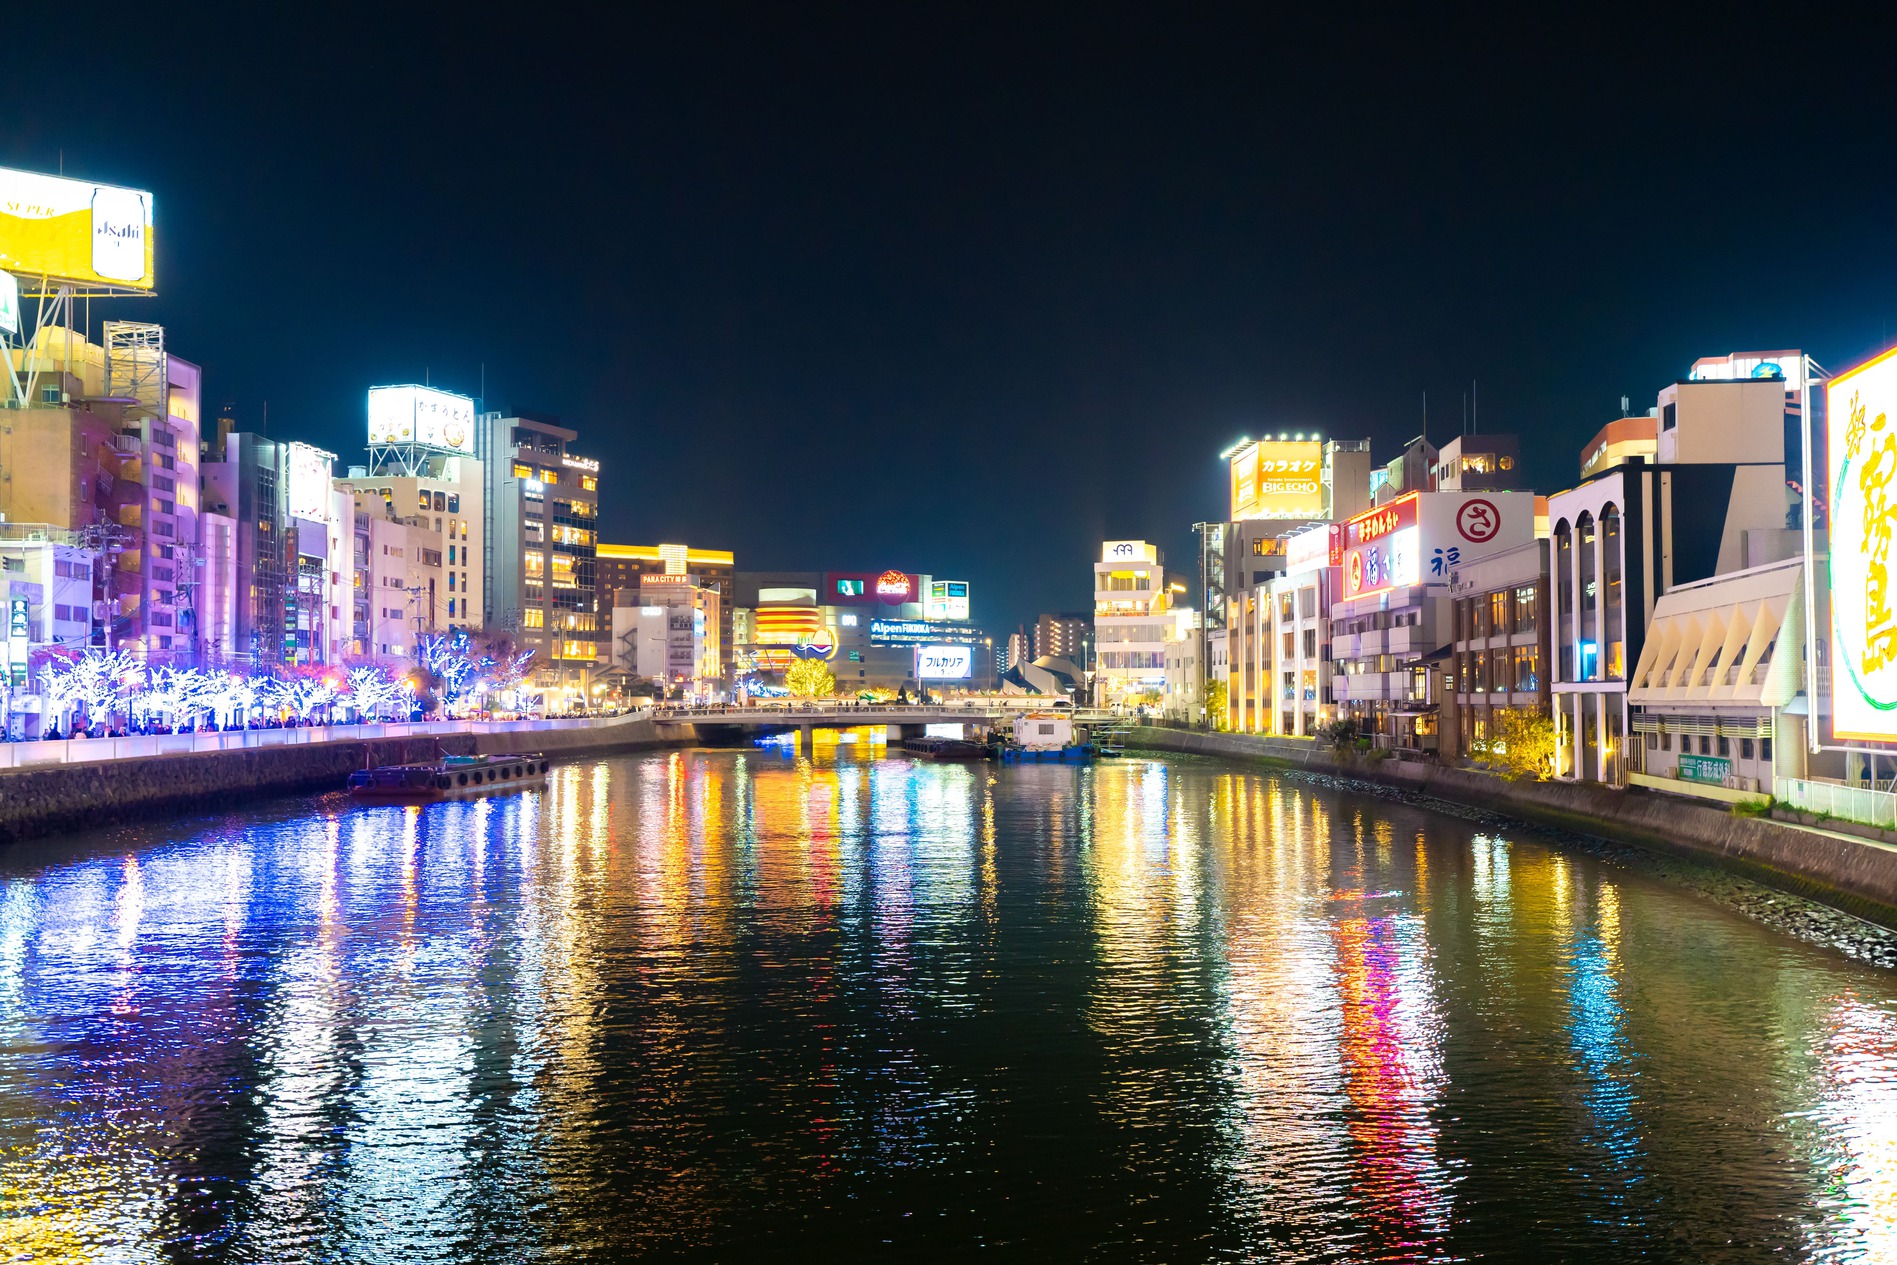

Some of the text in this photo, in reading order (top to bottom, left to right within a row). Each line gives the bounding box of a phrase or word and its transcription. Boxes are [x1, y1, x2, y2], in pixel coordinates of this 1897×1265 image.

[7, 201, 55, 217] SUPER
[97, 220, 140, 240] Asahi
[1262, 460, 1317, 473] カラオケ
[1262, 482, 1284, 493] BIG
[1285, 481, 1318, 493] ECHO
[871, 622, 930, 634] Alpen FUKUOKA
